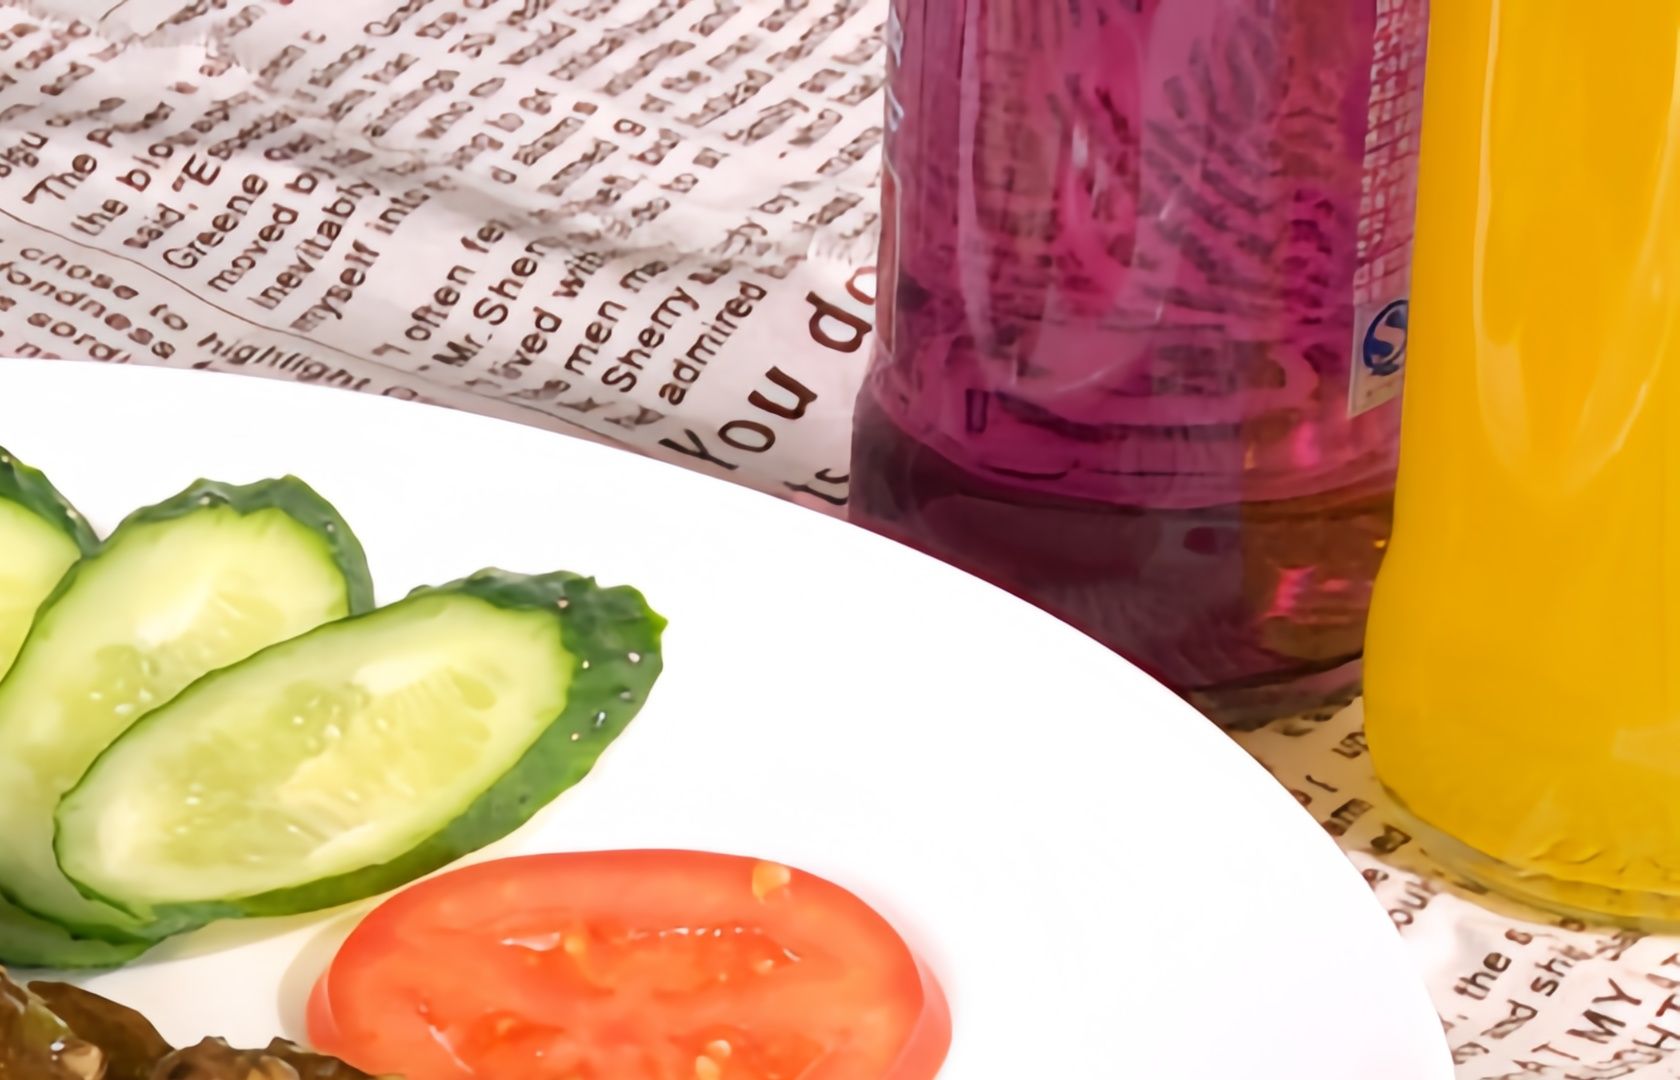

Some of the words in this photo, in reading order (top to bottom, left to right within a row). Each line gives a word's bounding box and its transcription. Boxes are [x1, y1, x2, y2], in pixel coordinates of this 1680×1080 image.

[162, 173, 269, 270] Greene
[206, 202, 300, 293] moved
[658, 280, 768, 407] admired
[656, 365, 819, 491] You
